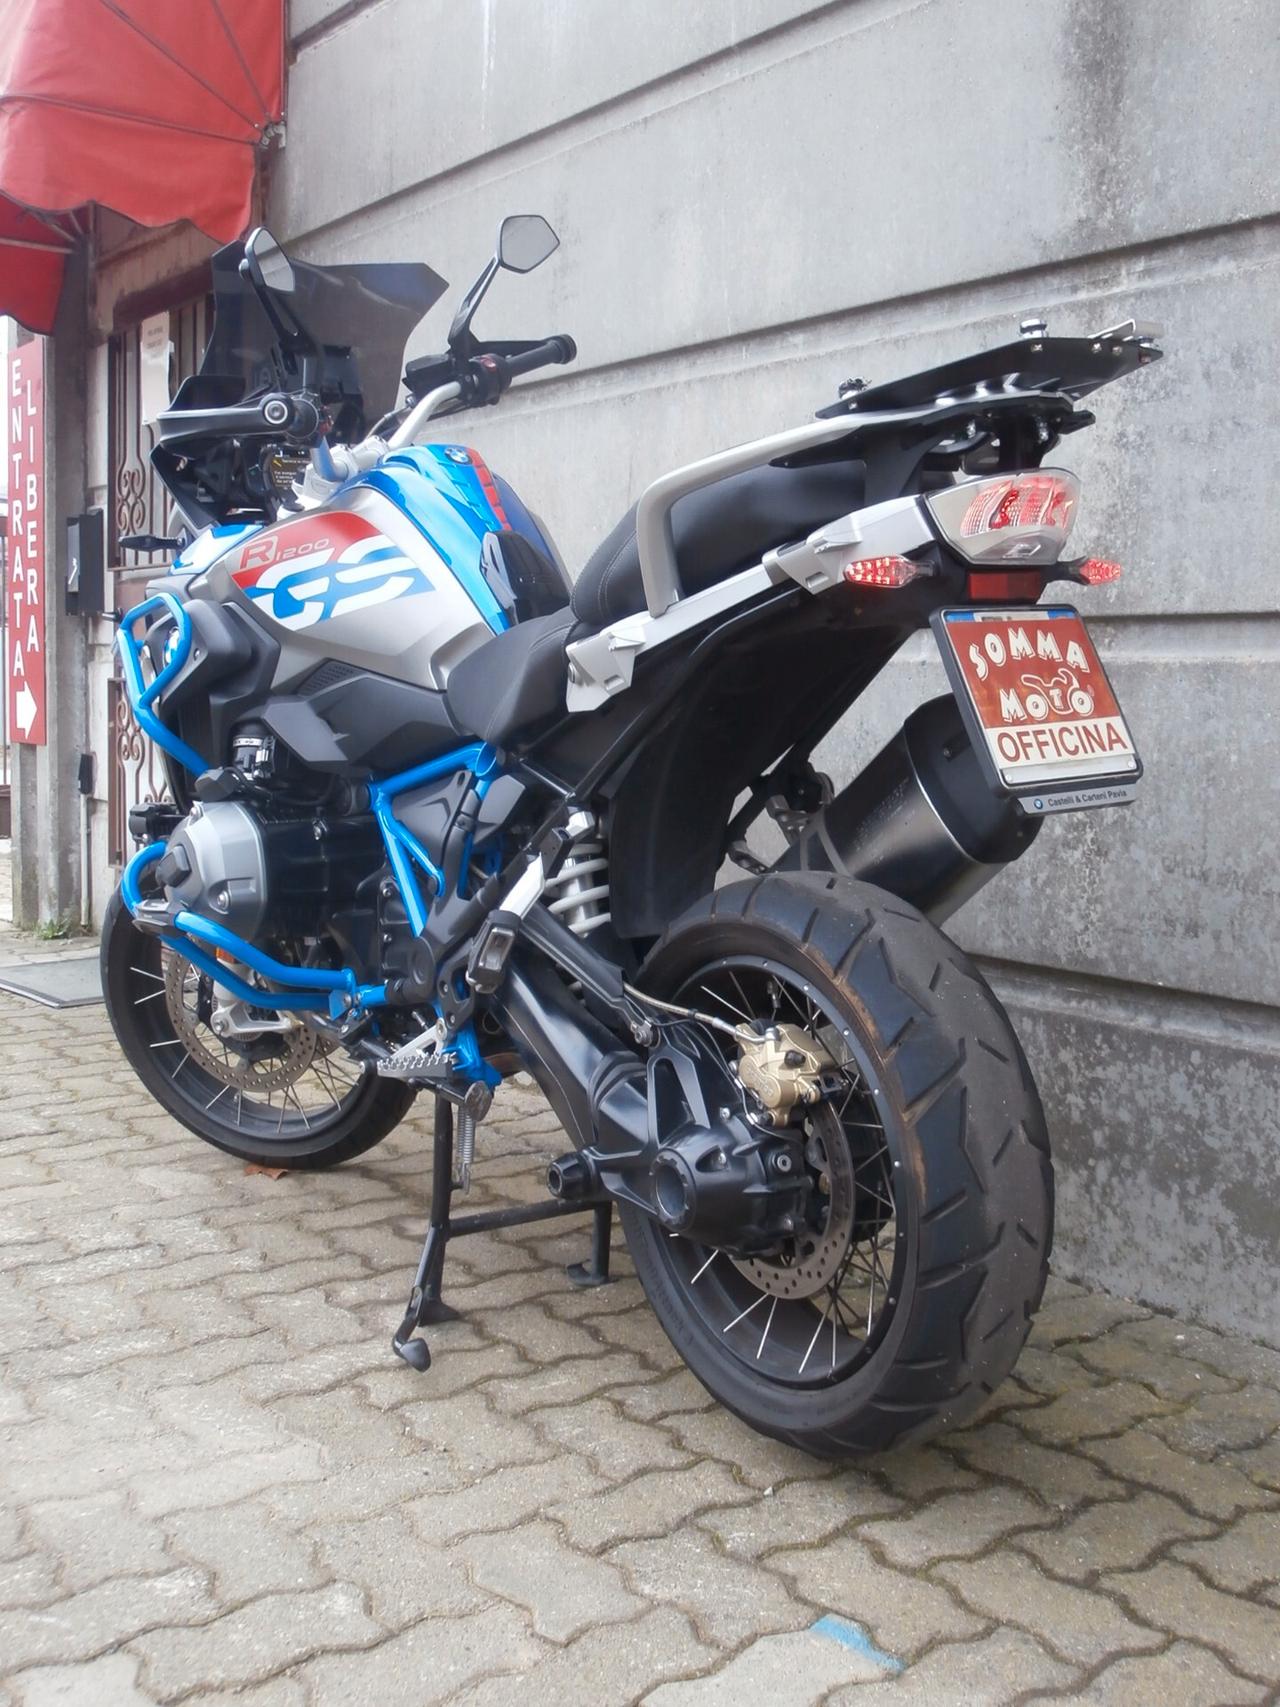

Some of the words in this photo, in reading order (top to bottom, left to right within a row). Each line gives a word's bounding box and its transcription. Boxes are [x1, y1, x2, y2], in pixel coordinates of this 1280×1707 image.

[12, 358, 25, 676] ENTRATA
[26, 379, 40, 653] LIBERA
[251, 535, 419, 631] GS
[969, 626, 1091, 681] SOMMA
[999, 687, 1094, 723] MOTO
[996, 721, 1128, 763] OFFICINA
[1047, 797, 1075, 807] Castelli
[1075, 795, 1082, 803] &
[1107, 789, 1127, 799] Pavia
